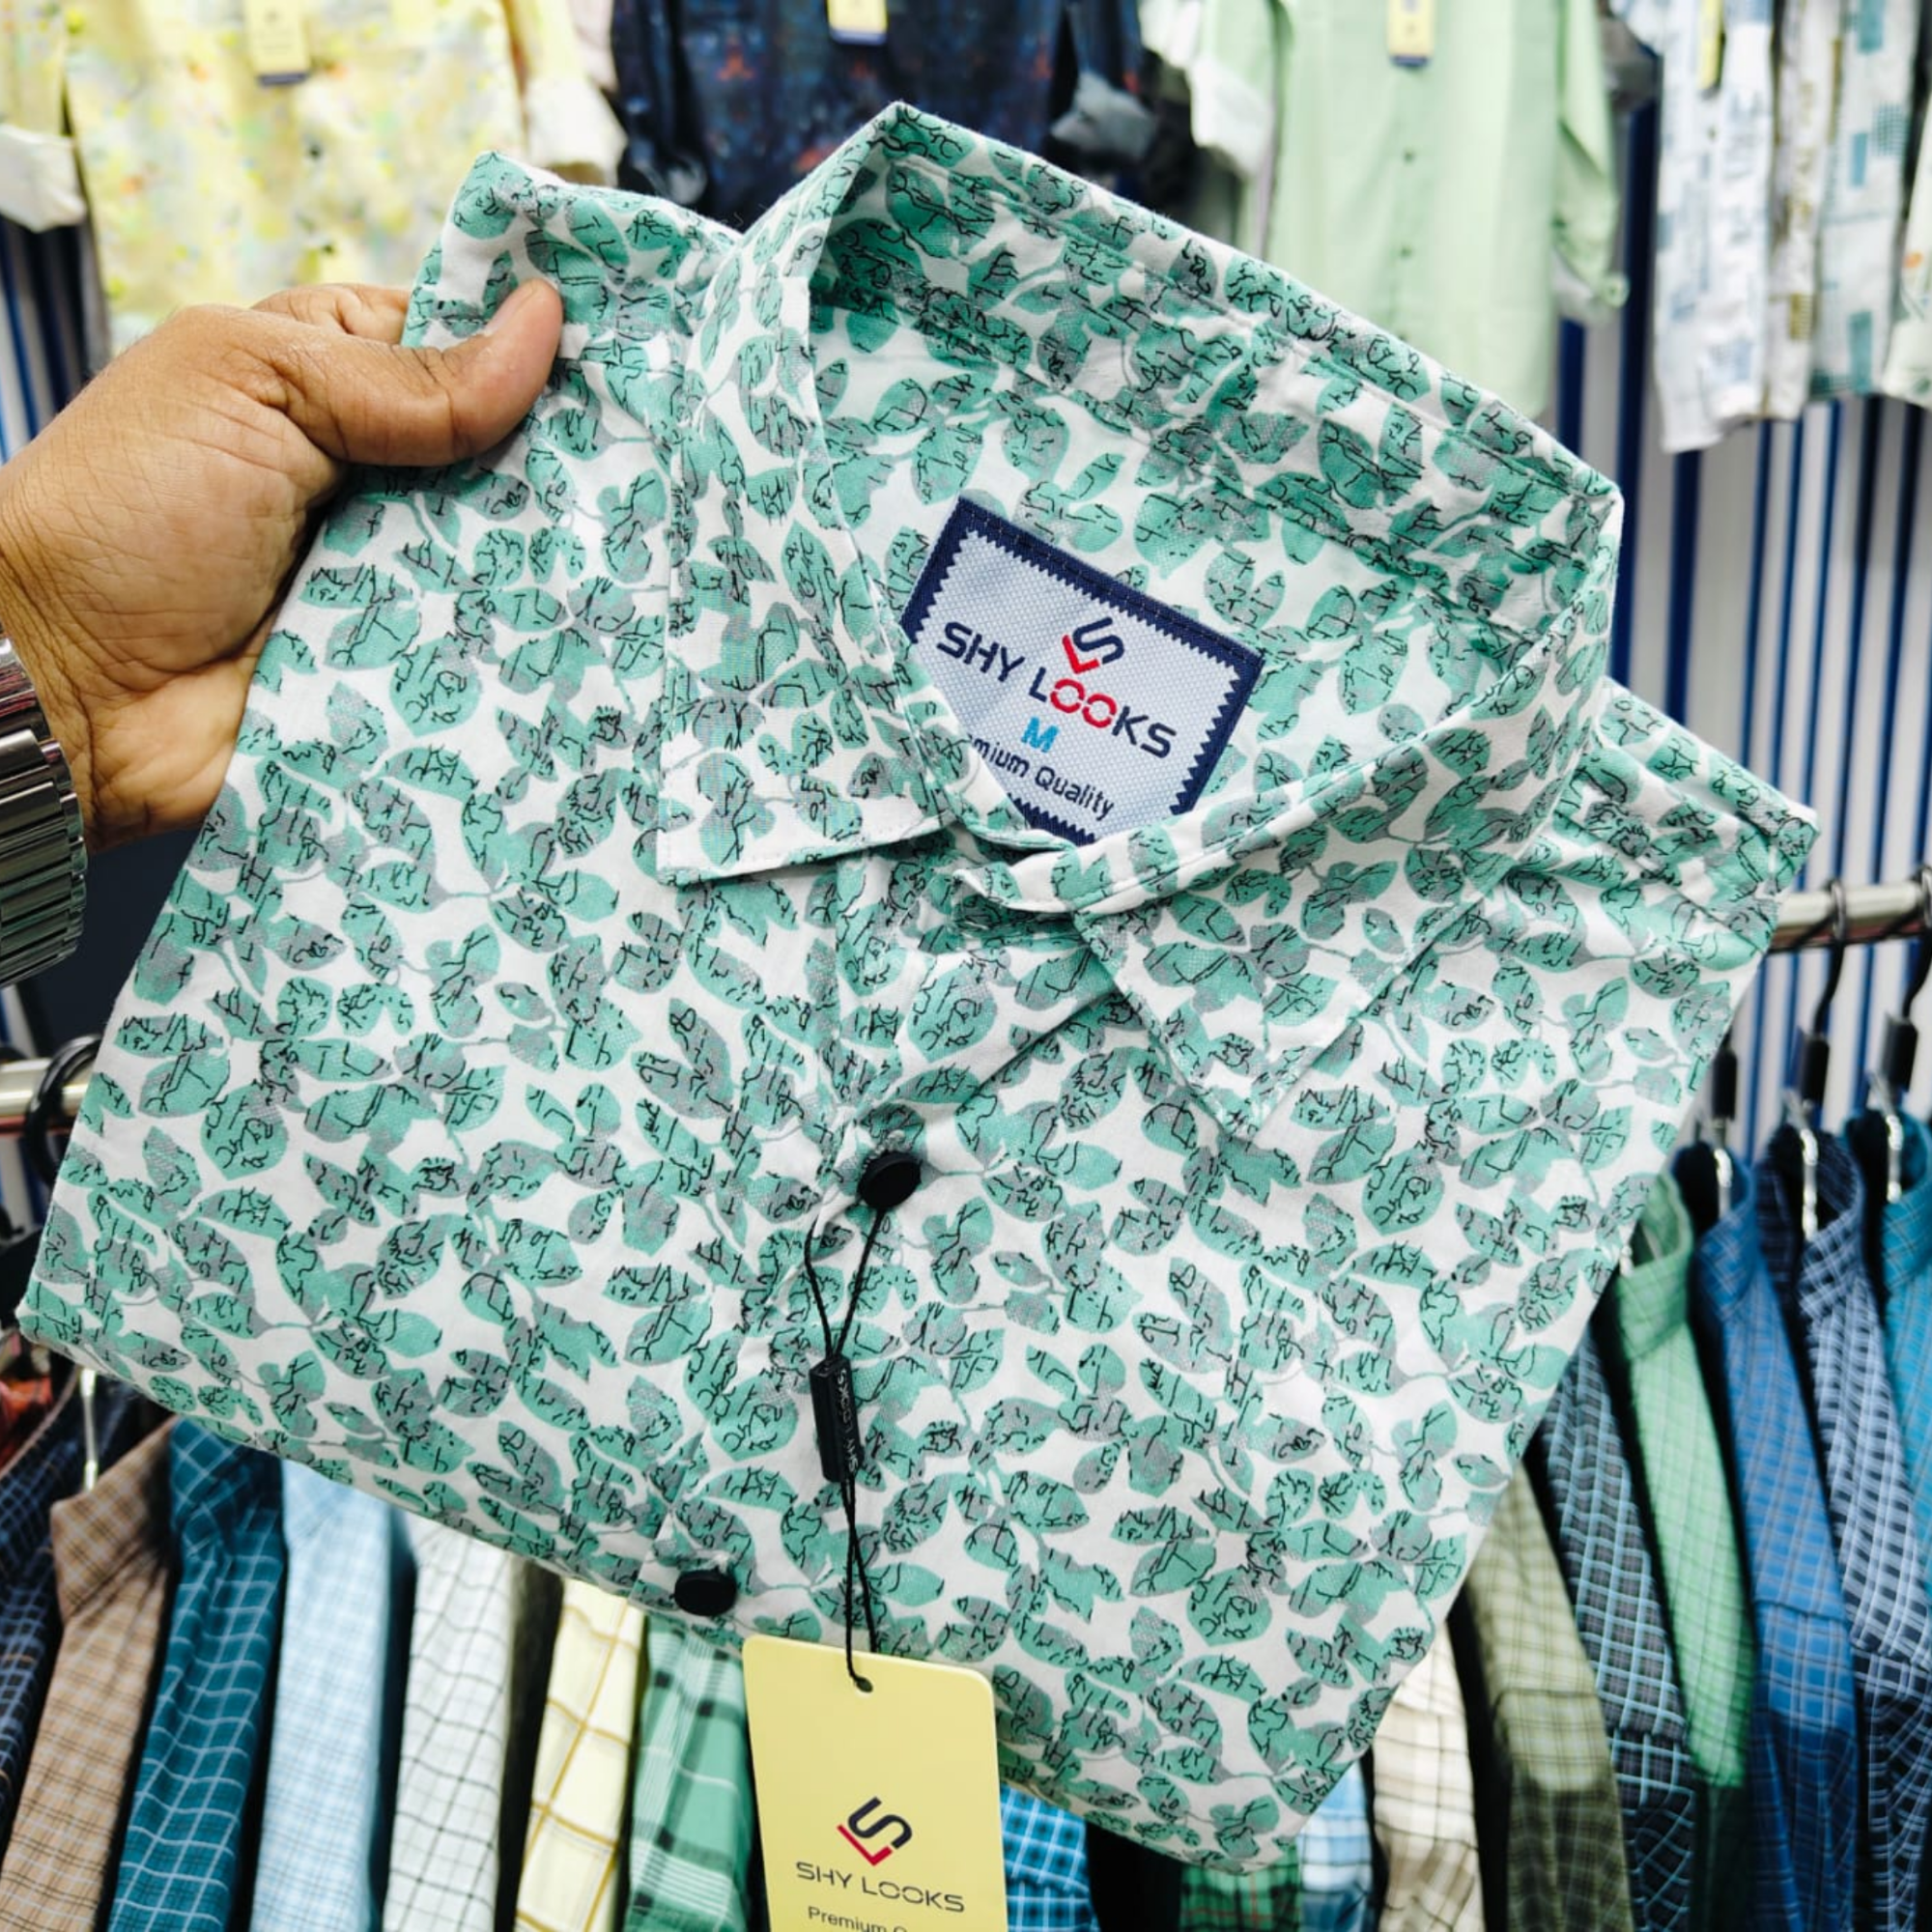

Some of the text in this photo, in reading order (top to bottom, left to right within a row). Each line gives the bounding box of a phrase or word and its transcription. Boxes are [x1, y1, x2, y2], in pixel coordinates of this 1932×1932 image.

[936, 621, 1178, 759] SHY LOOKS
[1020, 716, 1060, 753] M
[967, 733, 1115, 821] mium Quality
[796, 1861, 965, 1914] SHY LOOKS
[808, 1905, 888, 1932] Premium
